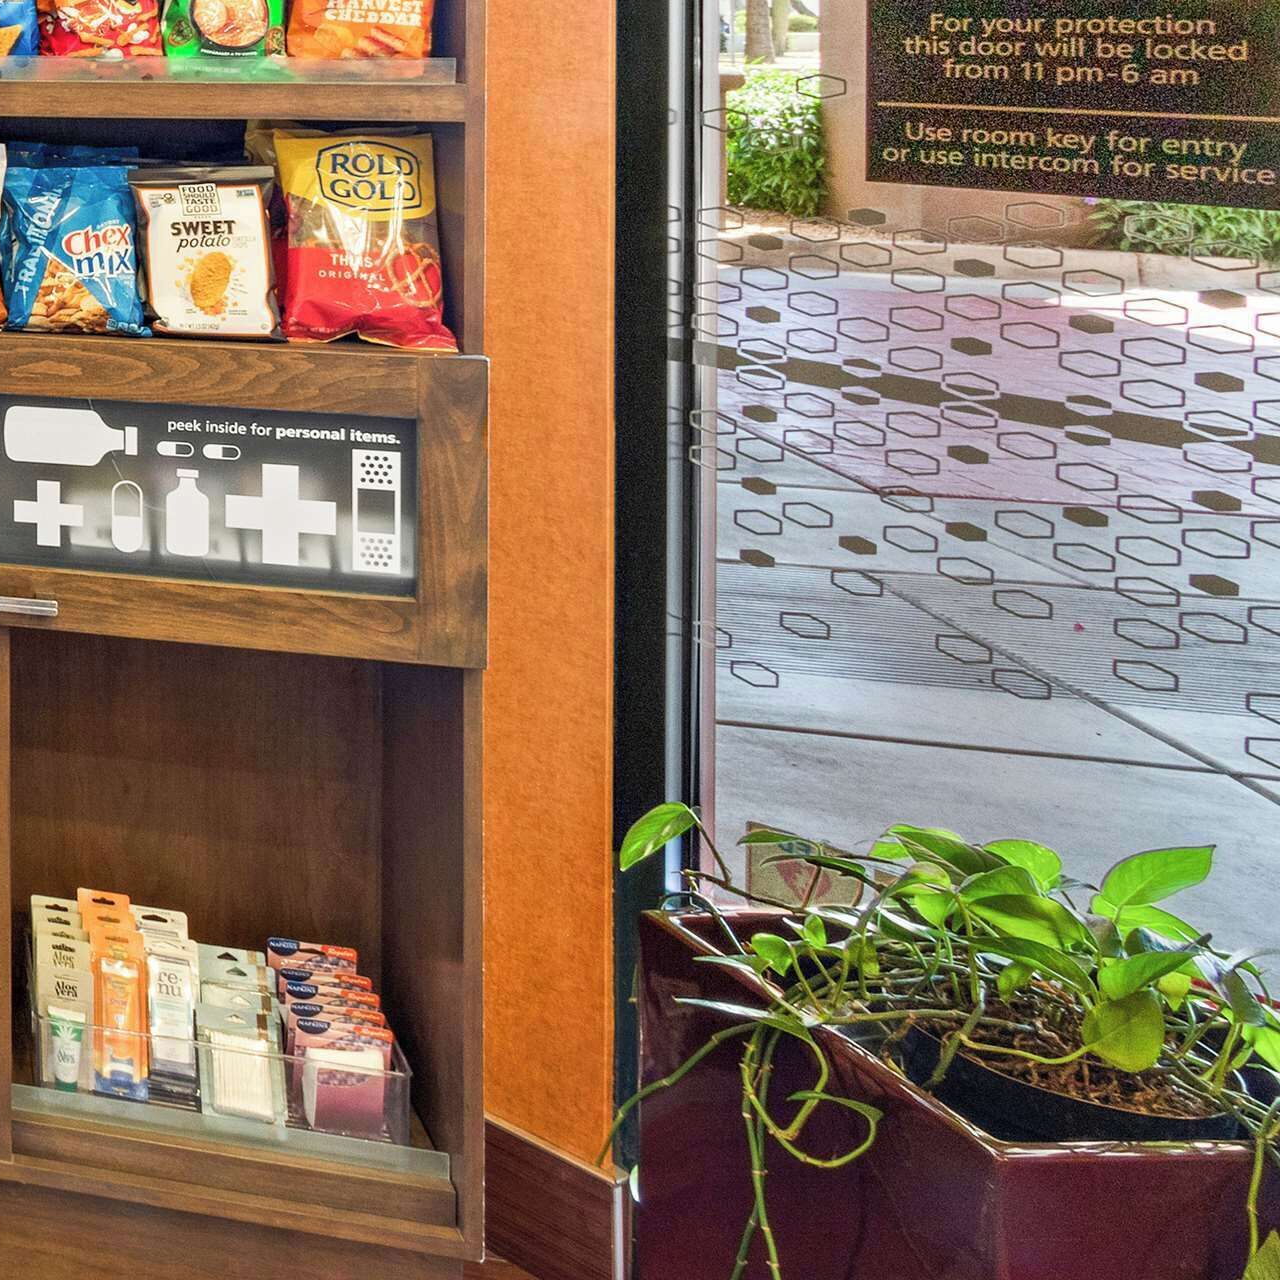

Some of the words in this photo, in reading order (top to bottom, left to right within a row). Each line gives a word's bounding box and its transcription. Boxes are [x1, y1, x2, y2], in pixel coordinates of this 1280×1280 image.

[324, 9, 423, 27] CHEDDAR
[929, 14, 970, 32] For
[981, 17, 1043, 38] your
[1054, 15, 1217, 38] protection
[903, 35, 950, 55] this
[958, 36, 1027, 58] door
[1035, 37, 1086, 58] will
[1096, 38, 1132, 59] be
[1145, 38, 1249, 62] locked
[943, 59, 1009, 81] from
[1020, 62, 1044, 81] 11
[1149, 68, 1201, 86] am
[905, 120, 953, 142] Use
[961, 128, 1037, 148] room
[1046, 127, 1096, 152] key
[1107, 131, 1151, 152] for
[1160, 137, 1248, 161] entry
[329, 151, 414, 179] ROLD
[881, 146, 910, 163] or
[918, 147, 965, 167] use
[973, 149, 1101, 176] intercom
[1112, 156, 1156, 178] for
[1165, 163, 1276, 187] service
[182, 184, 214, 193] FOOD
[183, 192, 216, 200] SHOULD
[329, 177, 416, 201] GOLD
[184, 197, 216, 206] TASTE
[185, 204, 219, 214] GOOD
[171, 219, 236, 237] SWEET
[63, 226, 130, 256] Chex
[176, 233, 232, 253] potato
[318, 269, 386, 282] ORIGINAL
[167, 419, 202, 433] peek
[205, 420, 247, 435] inside
[250, 422, 273, 437] for
[275, 426, 346, 441] personal
[349, 428, 401, 445] items.
[55, 986, 78, 998] Vera
[56, 980, 78, 991] Aloe
